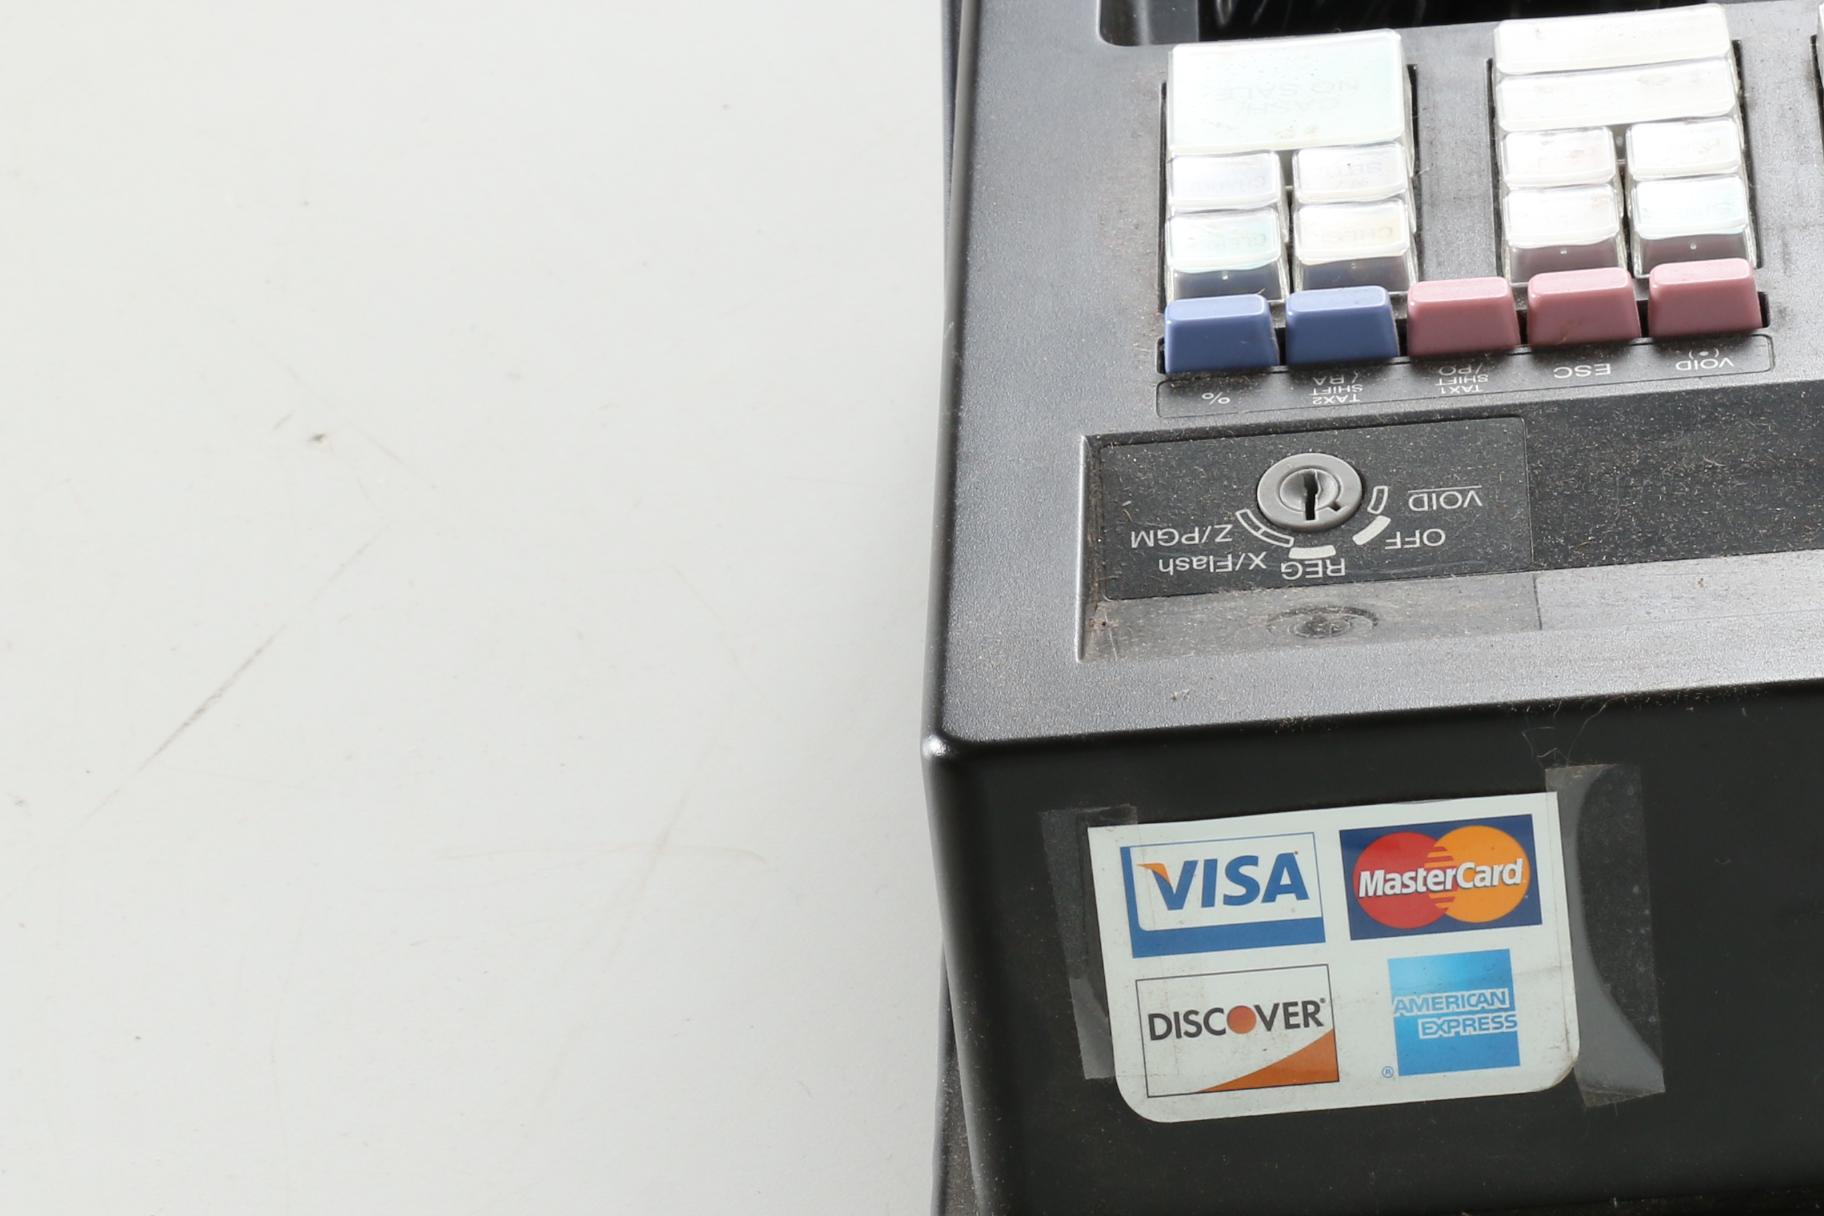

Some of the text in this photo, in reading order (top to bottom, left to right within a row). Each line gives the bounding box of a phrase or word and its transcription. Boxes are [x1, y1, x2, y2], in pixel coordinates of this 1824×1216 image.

[1553, 363, 1611, 378] ESC
[1675, 357, 1734, 371] VOID
[1309, 384, 1363, 396] SHIFT
[1435, 374, 1489, 386] SHIFT
[1440, 384, 1481, 394] TAX1
[1201, 391, 1230, 405] %
[1312, 394, 1360, 404] TAX2
[1408, 489, 1483, 511] VOID
[1131, 523, 1233, 548] Z/PGM
[1385, 528, 1446, 549] OFF
[1159, 551, 1267, 575] X/Flash
[1281, 558, 1345, 579] REG
[1136, 850, 1310, 911] VISA
[1358, 858, 1525, 898] MasterCard
[1393, 988, 1509, 1015] AMERICAN
[1148, 999, 1325, 1042] DISCOVER
[1419, 1012, 1518, 1038] EXPRESS
